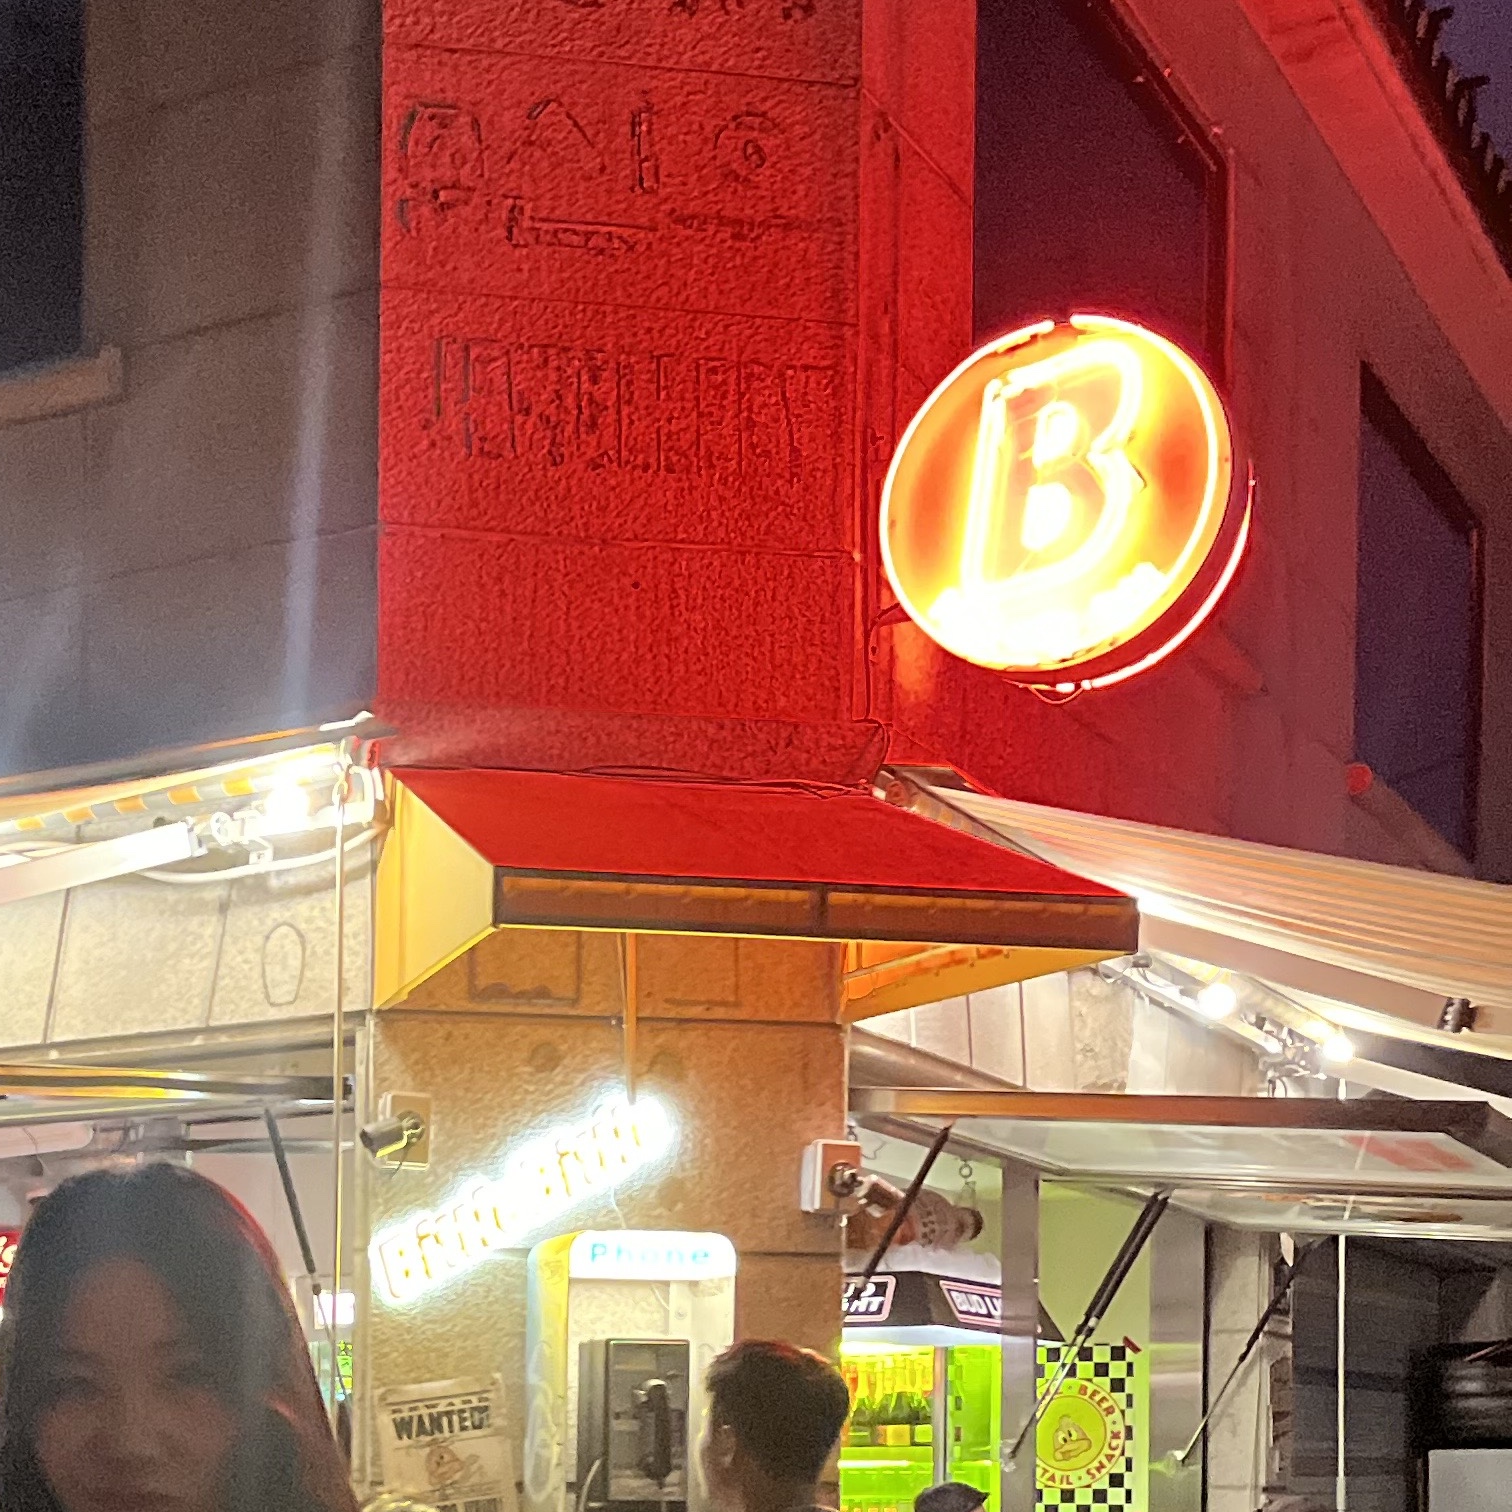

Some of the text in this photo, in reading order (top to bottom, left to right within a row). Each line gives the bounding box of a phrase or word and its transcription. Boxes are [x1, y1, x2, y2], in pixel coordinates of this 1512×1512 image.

[961, 339, 1144, 596] B
[590, 1242, 712, 1265] Phone
[1078, 1383, 1116, 1417] BEER
[391, 1404, 491, 1441] WANTED
[1086, 1430, 1122, 1481] SNACK
[1038, 1467, 1074, 1486] TAIL
